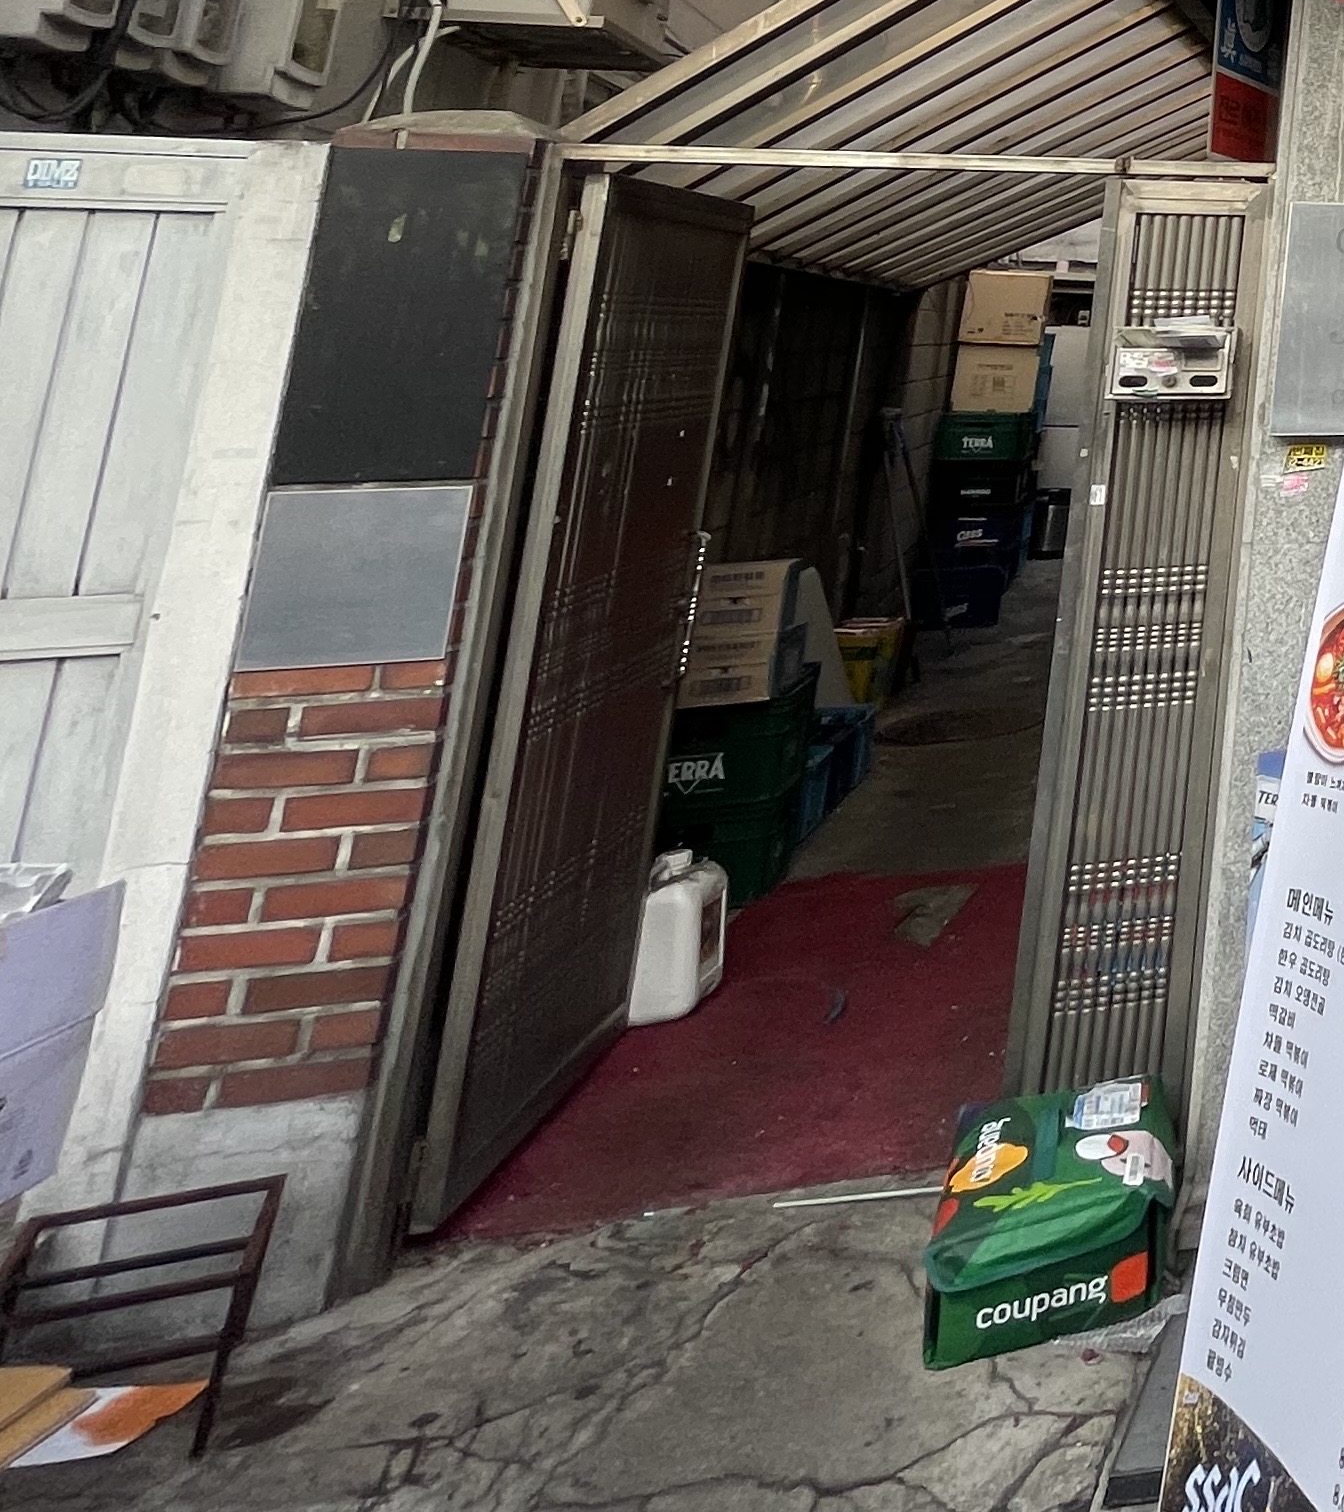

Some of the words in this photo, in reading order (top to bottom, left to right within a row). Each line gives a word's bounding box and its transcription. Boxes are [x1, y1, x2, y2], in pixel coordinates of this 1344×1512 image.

[667, 751, 726, 784] ERRA
[1286, 888, 1334, 926] 메인메뉴
[1283, 921, 1303, 944] 김치
[1304, 929, 1336, 959] 곱도리탕
[1273, 975, 1293, 999] 김치
[1278, 948, 1298, 970] 한우
[1299, 956, 1331, 987] 곱도리탕
[1269, 1003, 1296, 1030] 떡갈비
[1285, 1040, 1310, 1070] 떡볶이
[1257, 1059, 1278, 1083] 로제
[1280, 1068, 1304, 1099] 떡볶이
[1252, 1087, 1273, 1112] 짜장
[1275, 1097, 1299, 1128] 떡볶이
[1236, 1155, 1296, 1215] 사이드메뉴
[1254, 1210, 1286, 1251] 유부초밥
[1249, 1240, 1281, 1281] 유부초밥
[975, 1274, 1110, 1330] coupang
[1211, 1317, 1247, 1361] 감자튀김
